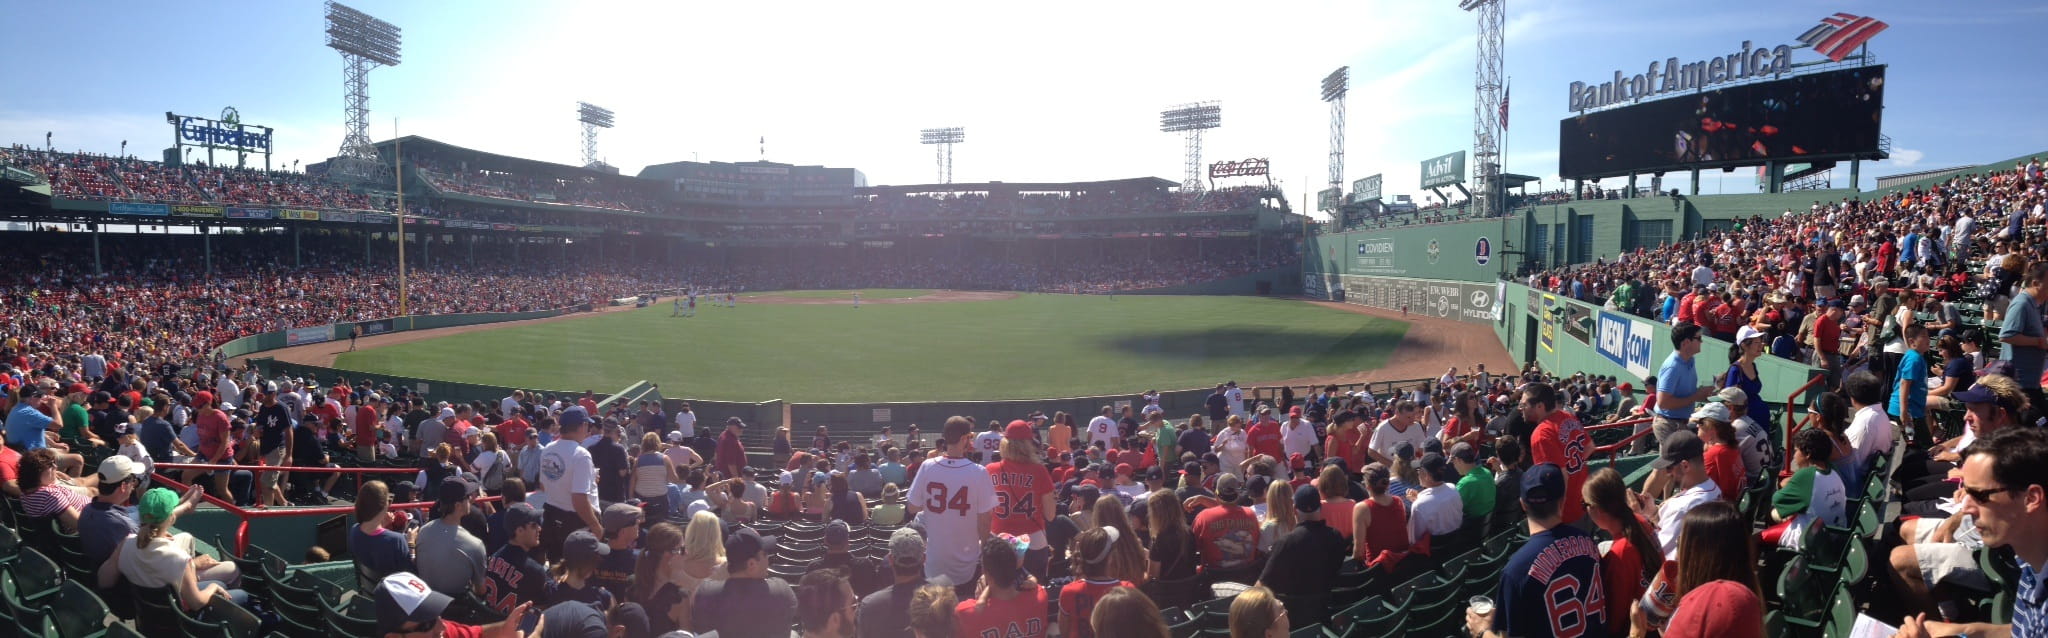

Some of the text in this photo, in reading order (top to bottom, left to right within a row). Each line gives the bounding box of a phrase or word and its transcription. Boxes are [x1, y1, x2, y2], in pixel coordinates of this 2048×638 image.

[1569, 40, 1792, 112] Bank of America
[181, 117, 271, 149] Cumberland
[1427, 156, 1453, 178] Advil
[1354, 176, 1381, 193] SPORTS
[1365, 242, 1393, 254] COVIDIEN
[1463, 308, 1495, 321] HYUNDA
[1600, 316, 1626, 359] NESN
[991, 472, 1033, 488] ORTIZ
[926, 481, 971, 517] 34
[992, 491, 1036, 519] 34
[1543, 562, 1607, 638] 64
[981, 617, 1042, 638] DAD
